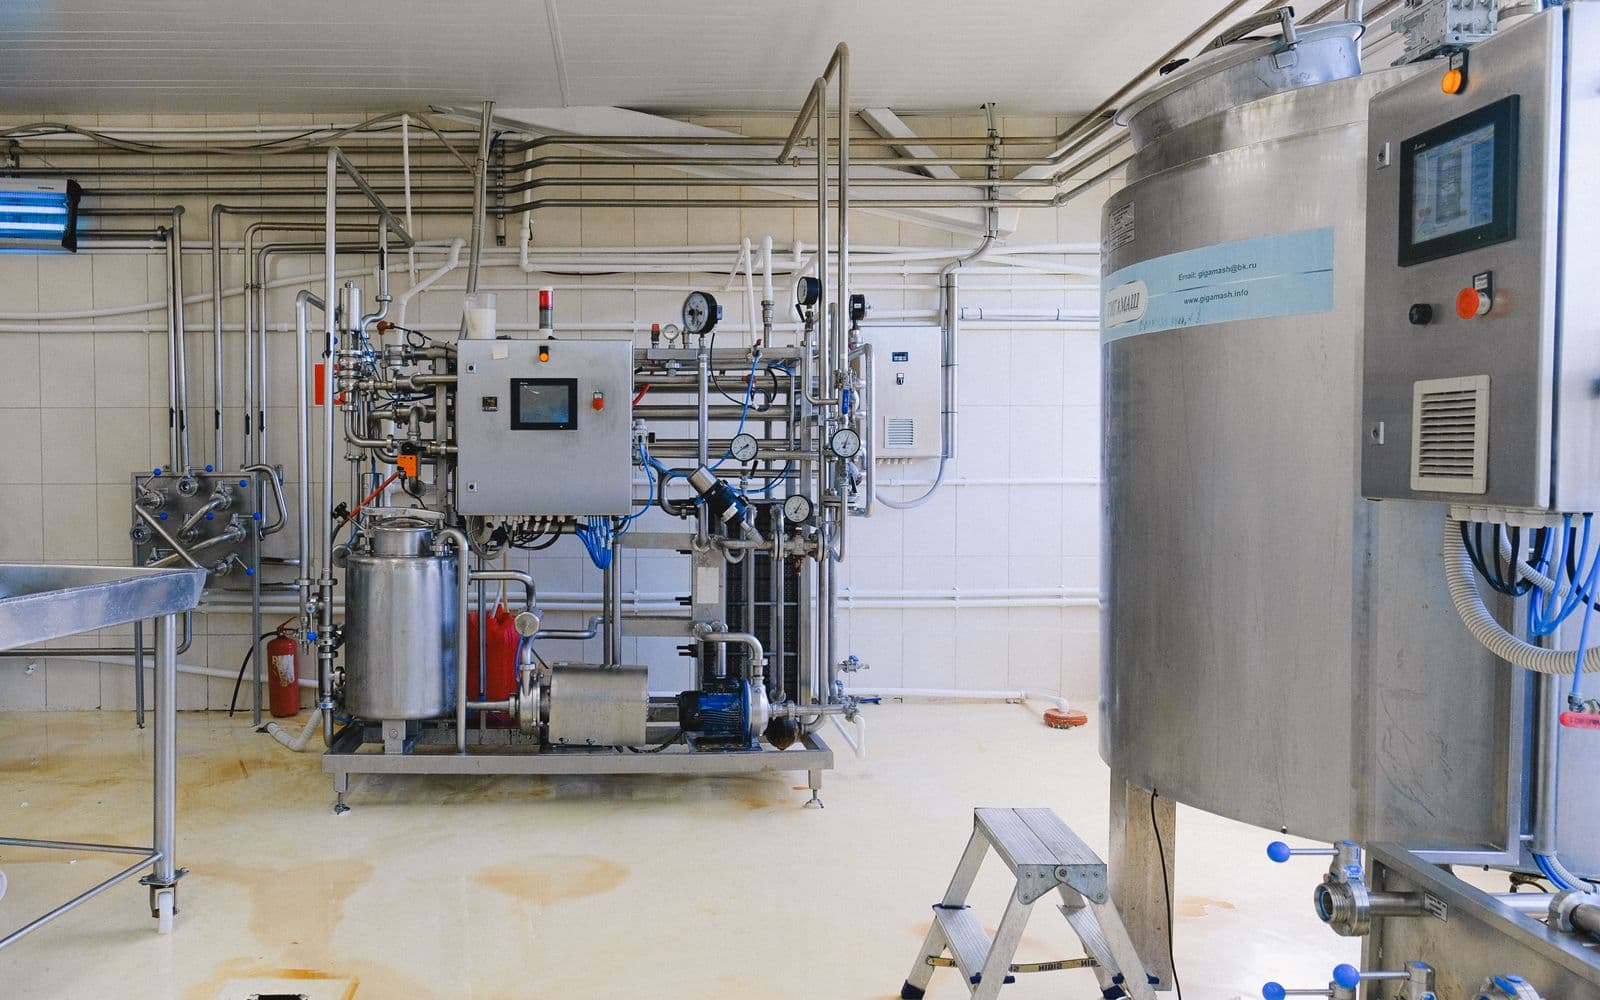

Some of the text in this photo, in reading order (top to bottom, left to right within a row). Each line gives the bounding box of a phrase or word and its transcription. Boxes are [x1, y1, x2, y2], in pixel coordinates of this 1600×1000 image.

[1178, 262, 1257, 281] Email: gigamash@bk.ru
[1183, 288, 1249, 305] www.gigamash.info
